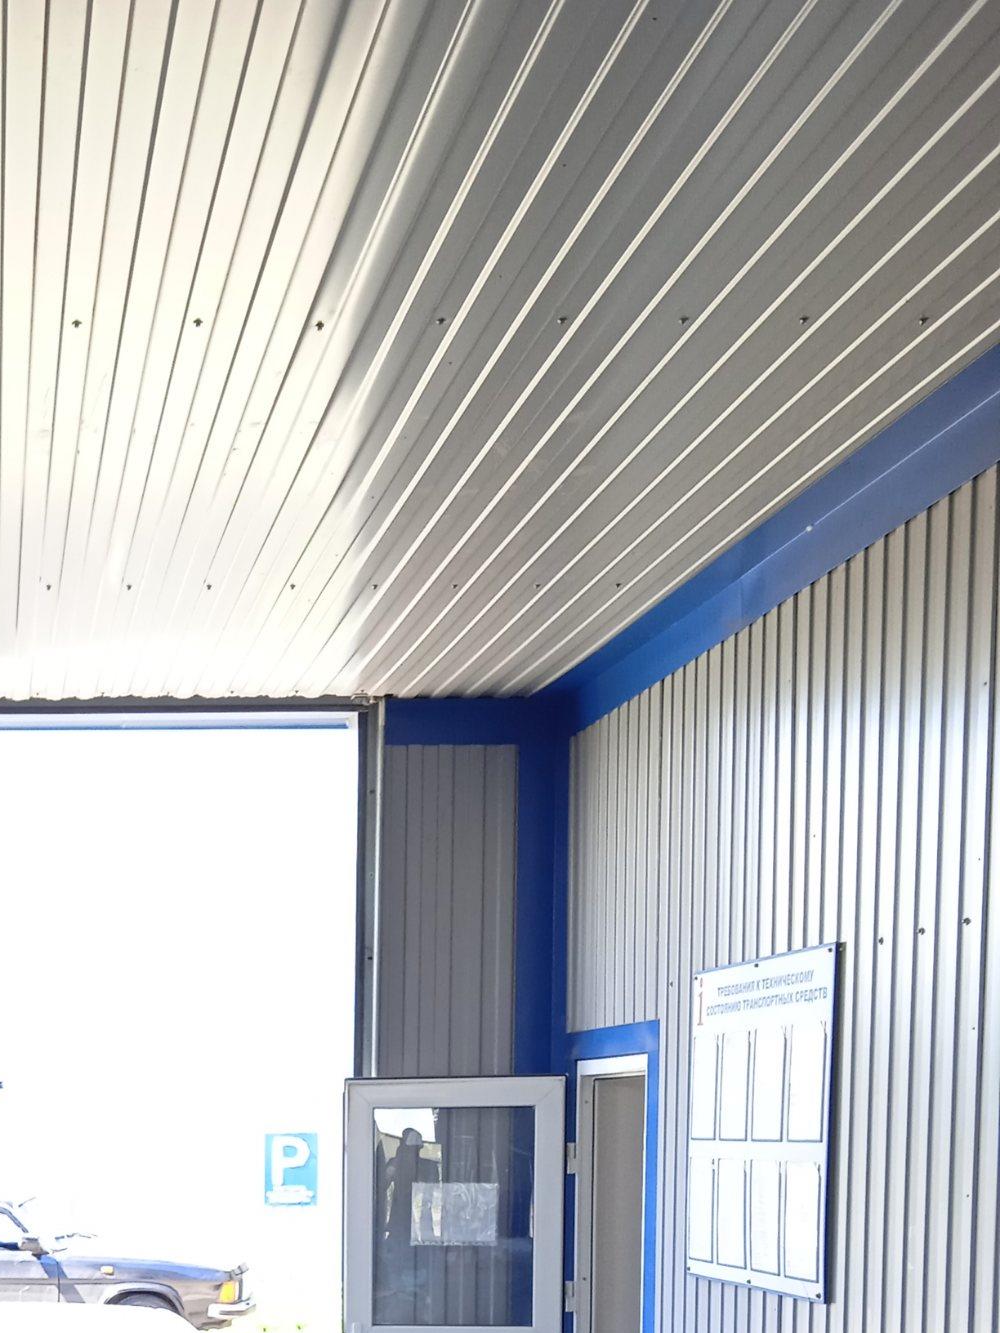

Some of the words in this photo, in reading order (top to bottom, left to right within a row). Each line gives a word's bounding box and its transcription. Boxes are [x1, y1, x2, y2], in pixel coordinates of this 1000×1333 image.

[717, 980, 756, 997] ТРЕБОВАНИЯ
[762, 969, 814, 989] ТЕХНИЧЕСКОМУ
[706, 1001, 741, 1016] СОСТОЯНИЮ
[743, 993, 794, 1010] ТРАНСПОРТНЫХ
[795, 986, 828, 1003] СРЕДСТВ
